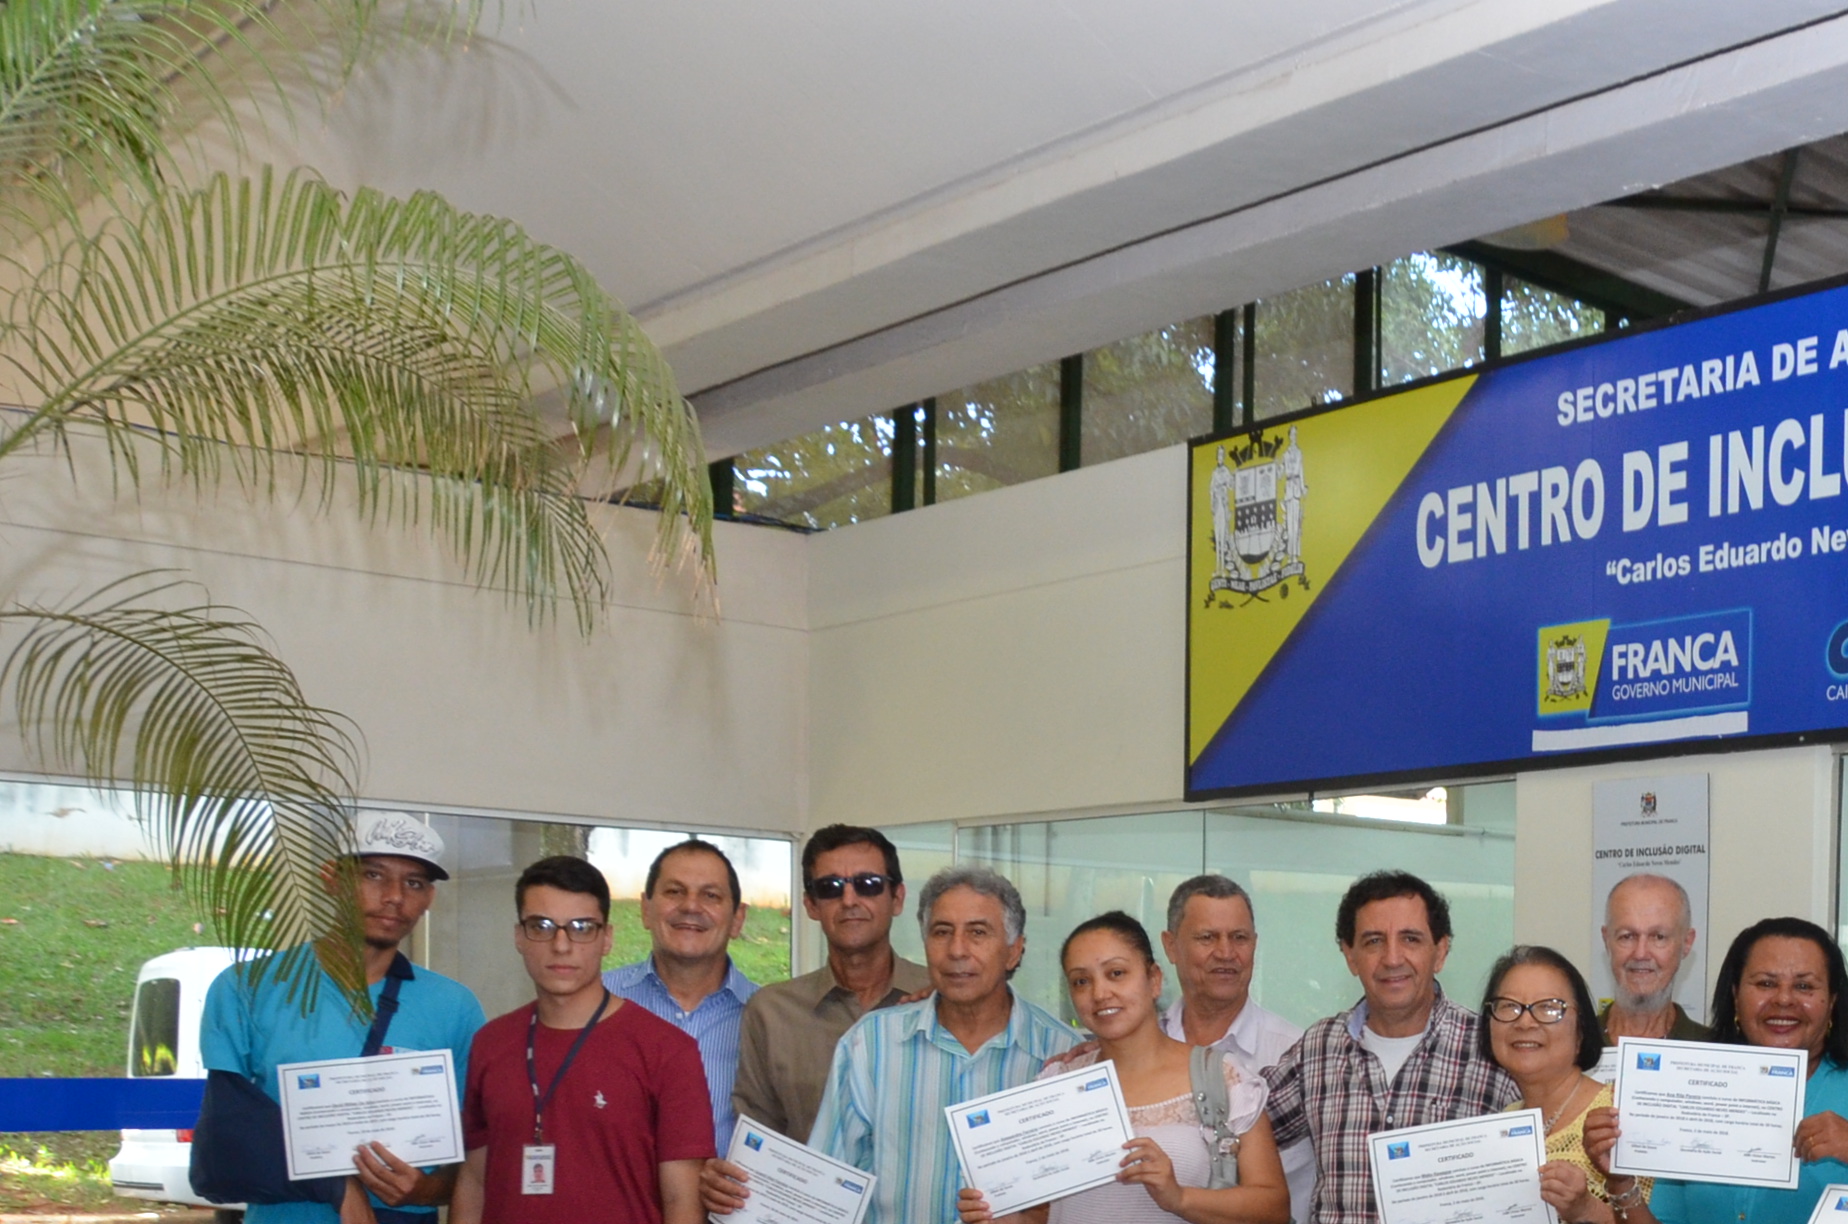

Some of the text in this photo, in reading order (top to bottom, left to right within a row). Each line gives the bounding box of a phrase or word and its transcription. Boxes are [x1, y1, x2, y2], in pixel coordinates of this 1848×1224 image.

[1556, 351, 1760, 427] SECRETARIA
[1772, 336, 1819, 380] DE
[1415, 459, 1604, 568] CENTRO
[1622, 440, 1688, 532] DE
[1698, 532, 1802, 573] Eduardo
[1612, 630, 1739, 681] FRANCA
[1612, 671, 1739, 700] GOVERNO MUNICIPAL
[1595, 844, 1706, 859] CENTRO DE INCLUSÃO DIGITAL
[1687, 1079, 1727, 1088] CERTIFICADO
[1018, 1109, 1054, 1124] CERTIFICADO
[1437, 1152, 1474, 1163] CERTIFICADO
